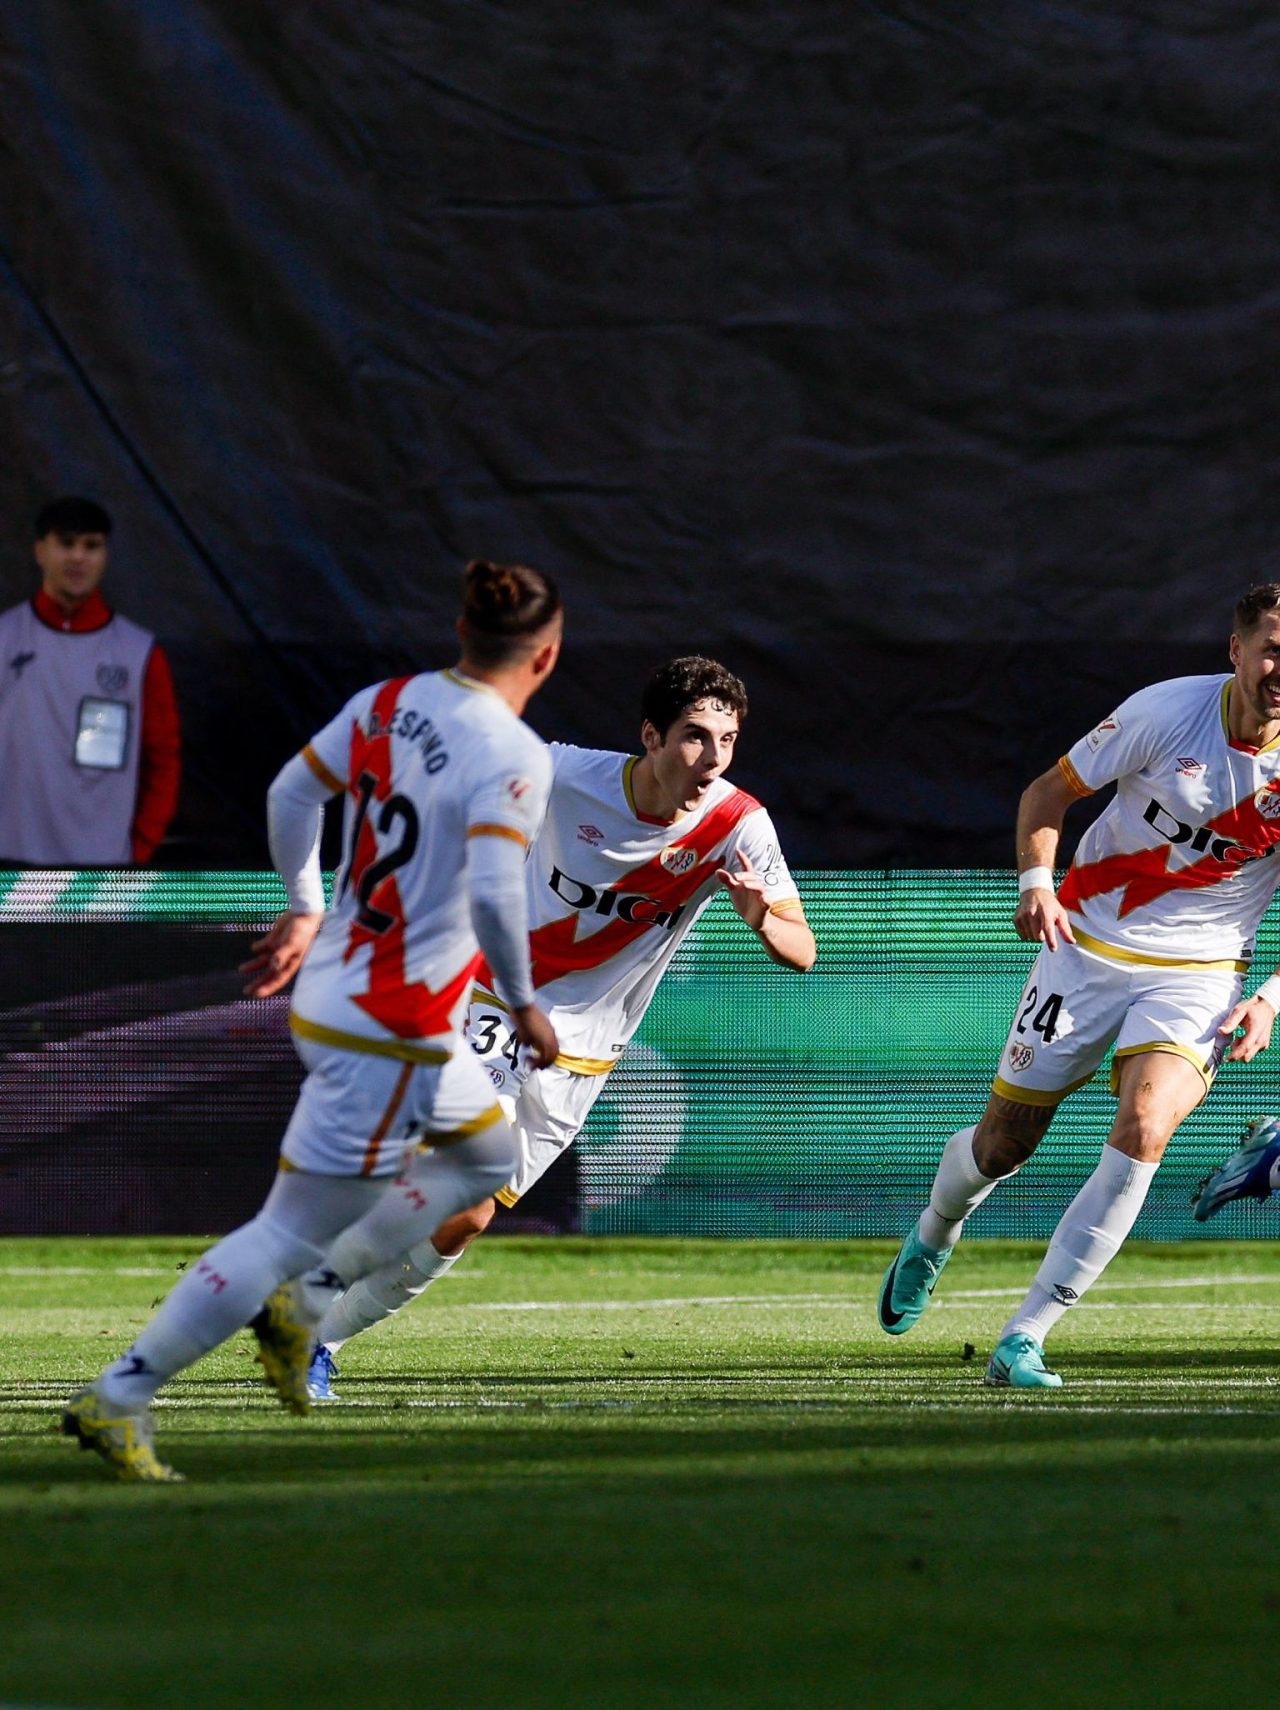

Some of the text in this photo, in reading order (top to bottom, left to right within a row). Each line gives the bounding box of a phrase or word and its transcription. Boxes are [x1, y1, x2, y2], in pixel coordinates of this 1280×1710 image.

[337, 771, 420, 934] 12
[471, 1014, 520, 1071] 34
[1016, 985, 1065, 1043] 24
